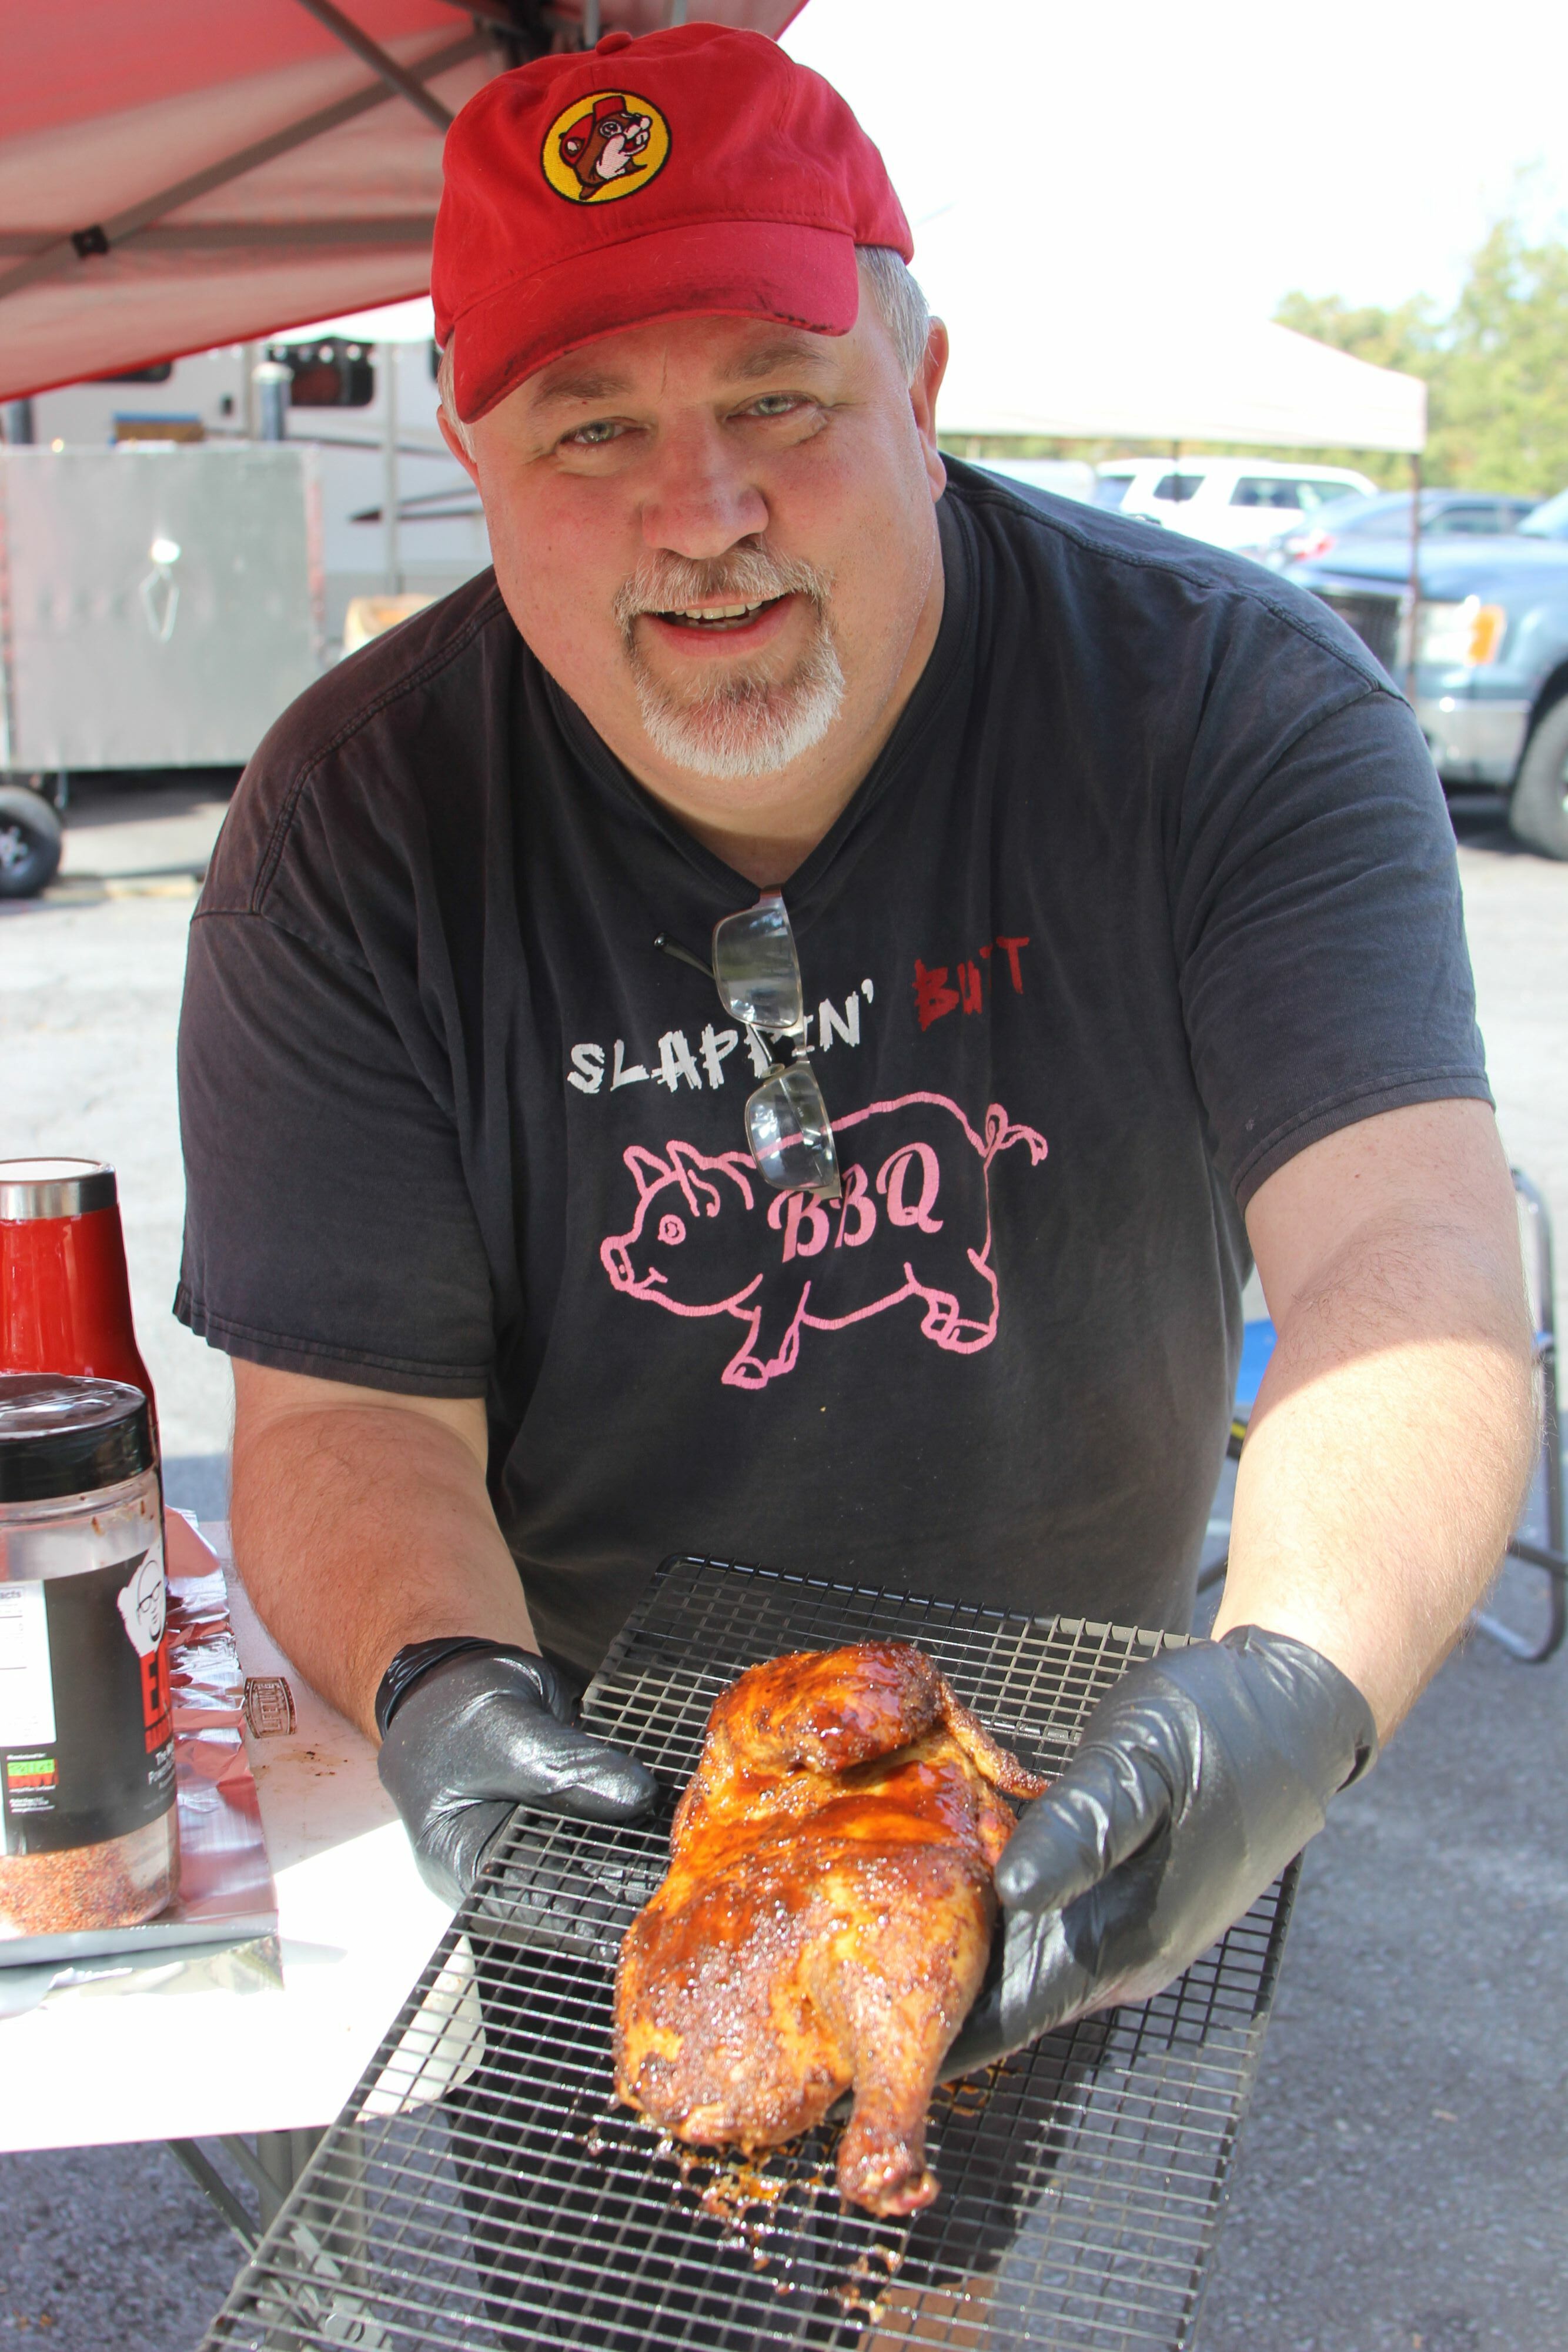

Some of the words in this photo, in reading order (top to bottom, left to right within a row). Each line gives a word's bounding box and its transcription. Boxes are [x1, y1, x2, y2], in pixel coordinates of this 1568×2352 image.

[912, 936, 1029, 1033] BUT
[767, 1142, 943, 1263] BBQ
[0, 1589, 22, 1599] acts
